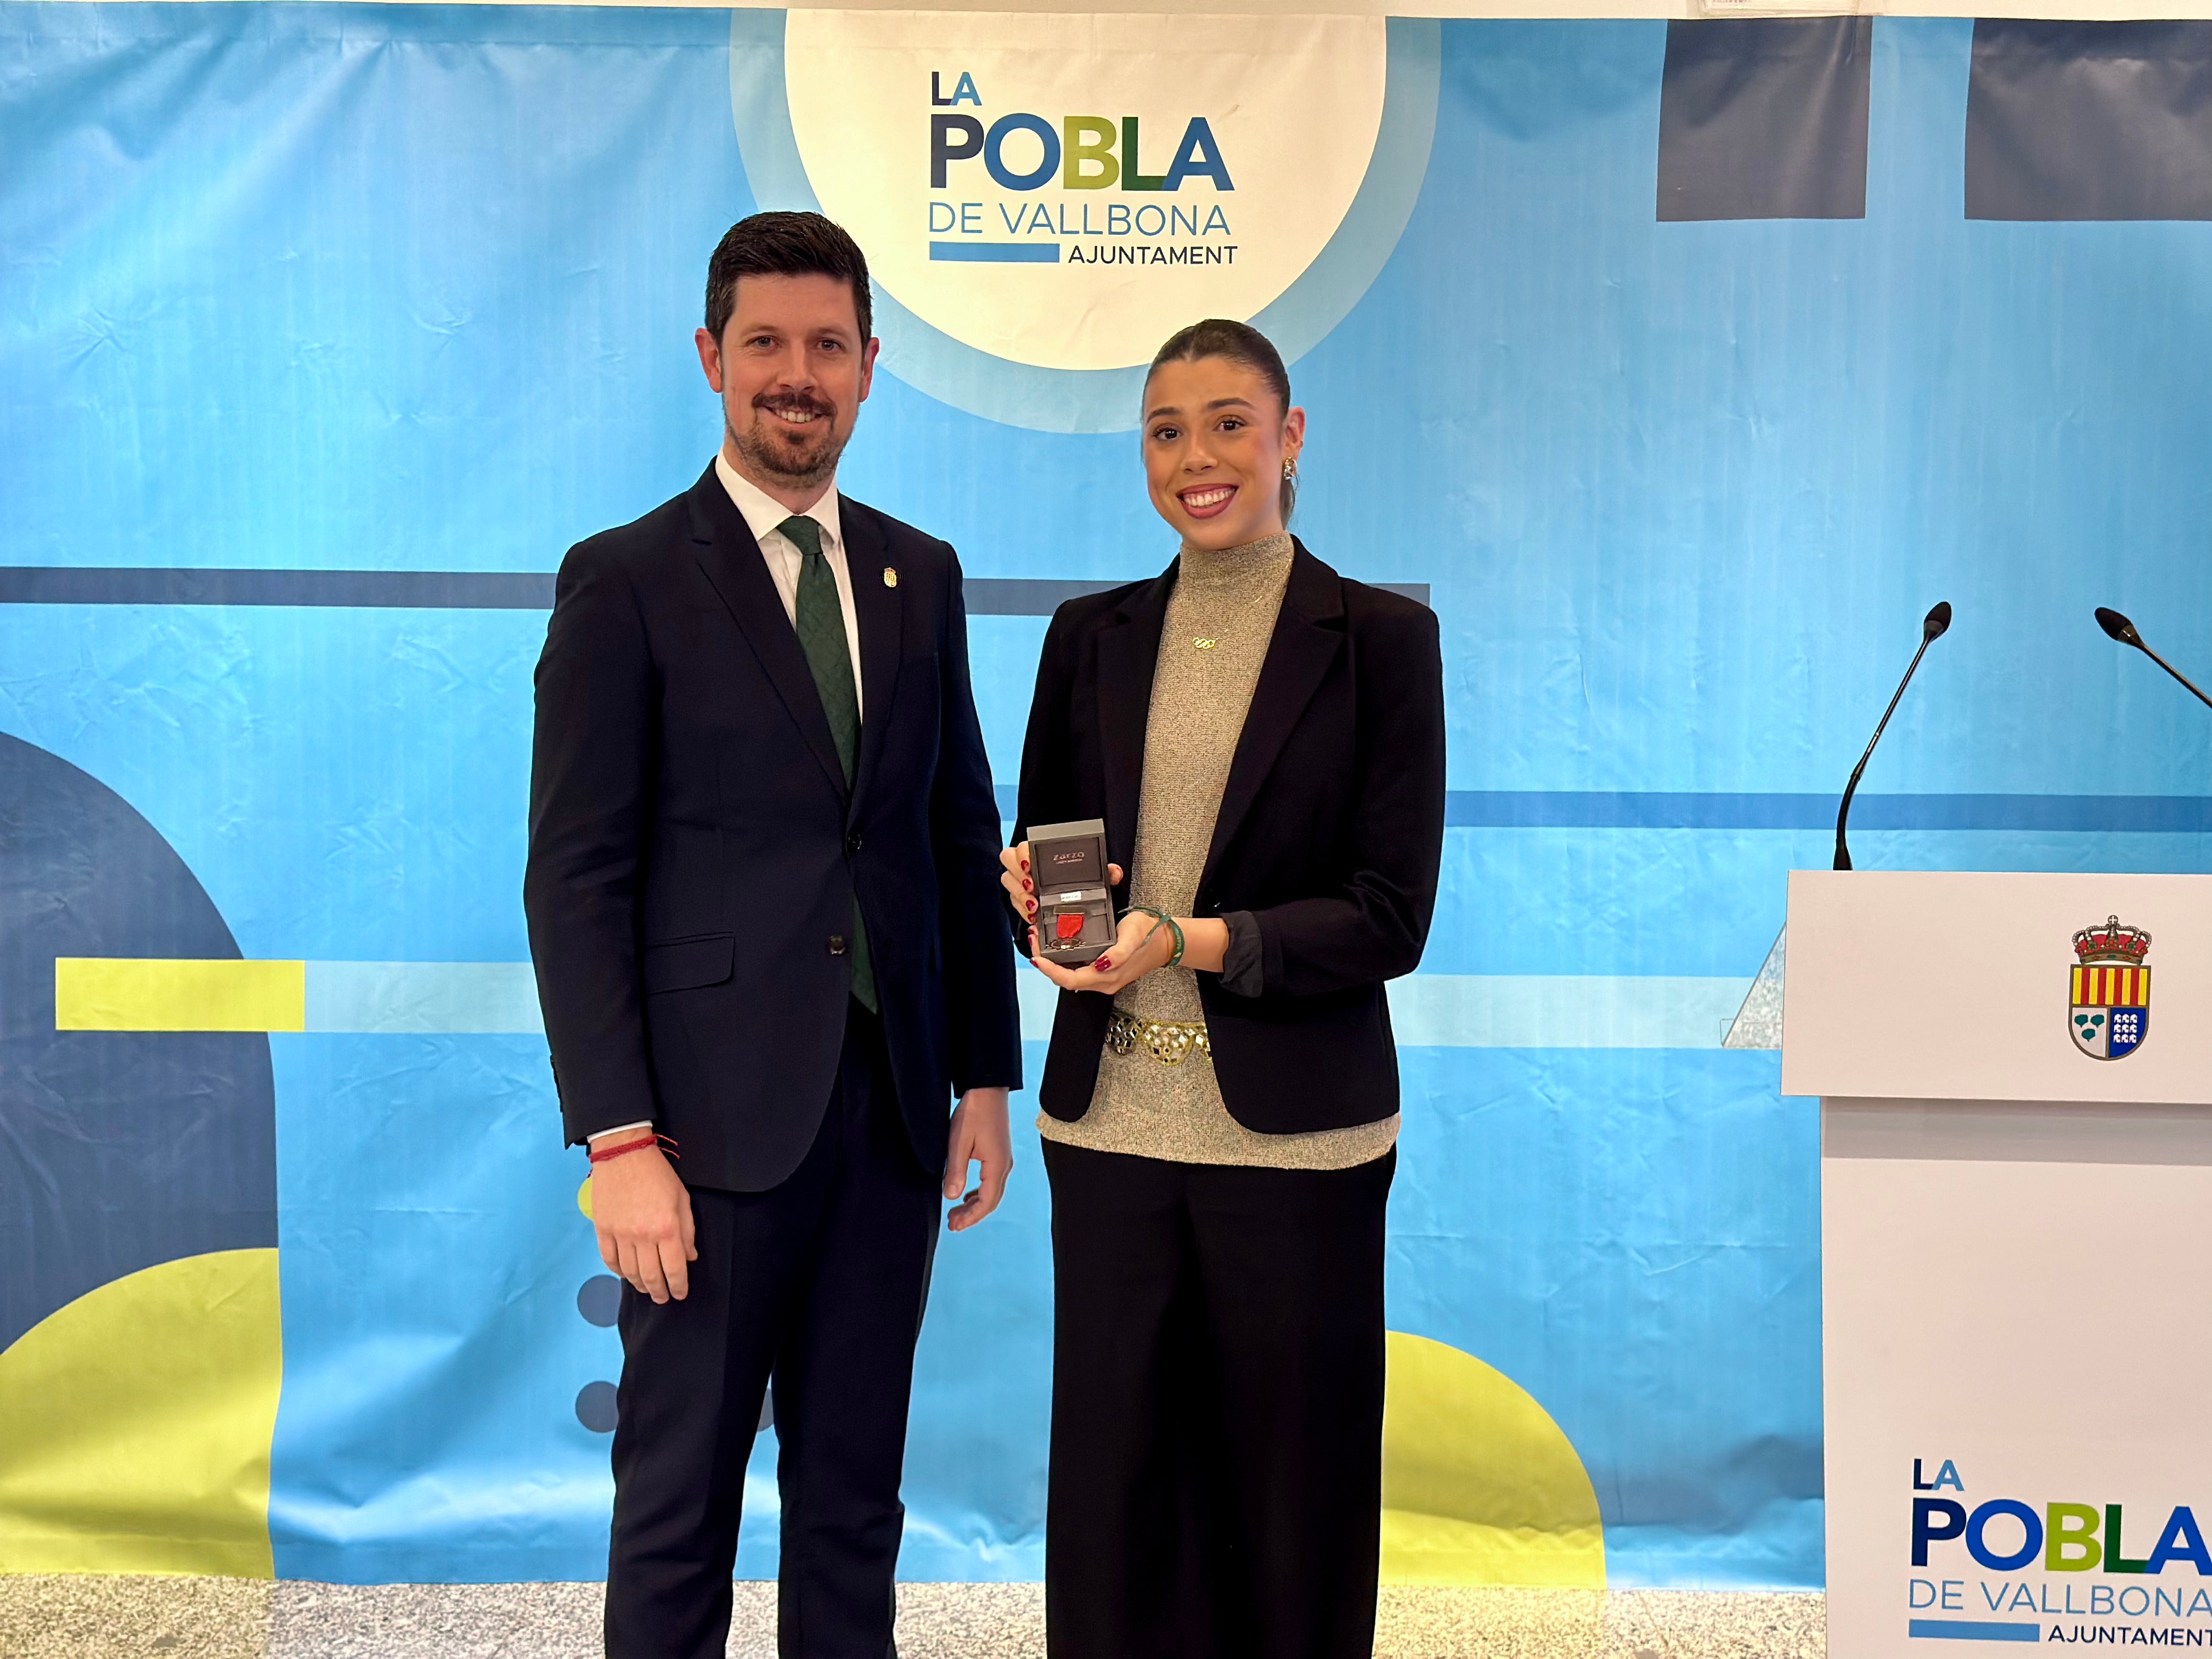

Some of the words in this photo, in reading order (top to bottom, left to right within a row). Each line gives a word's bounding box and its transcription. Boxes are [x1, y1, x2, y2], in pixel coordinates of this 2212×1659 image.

[932, 71, 982, 106] LA
[930, 113, 1235, 191] POBLA
[929, 202, 983, 233] DE
[999, 203, 1231, 236] VALLBONA
[1069, 245, 1238, 264] AJUNTAMENT
[1913, 1459, 1965, 1491] LA
[1911, 1497, 2212, 1576] POBLA
[1909, 1579, 1964, 1610] DE
[1980, 1582, 2212, 1617] VALLBONA
